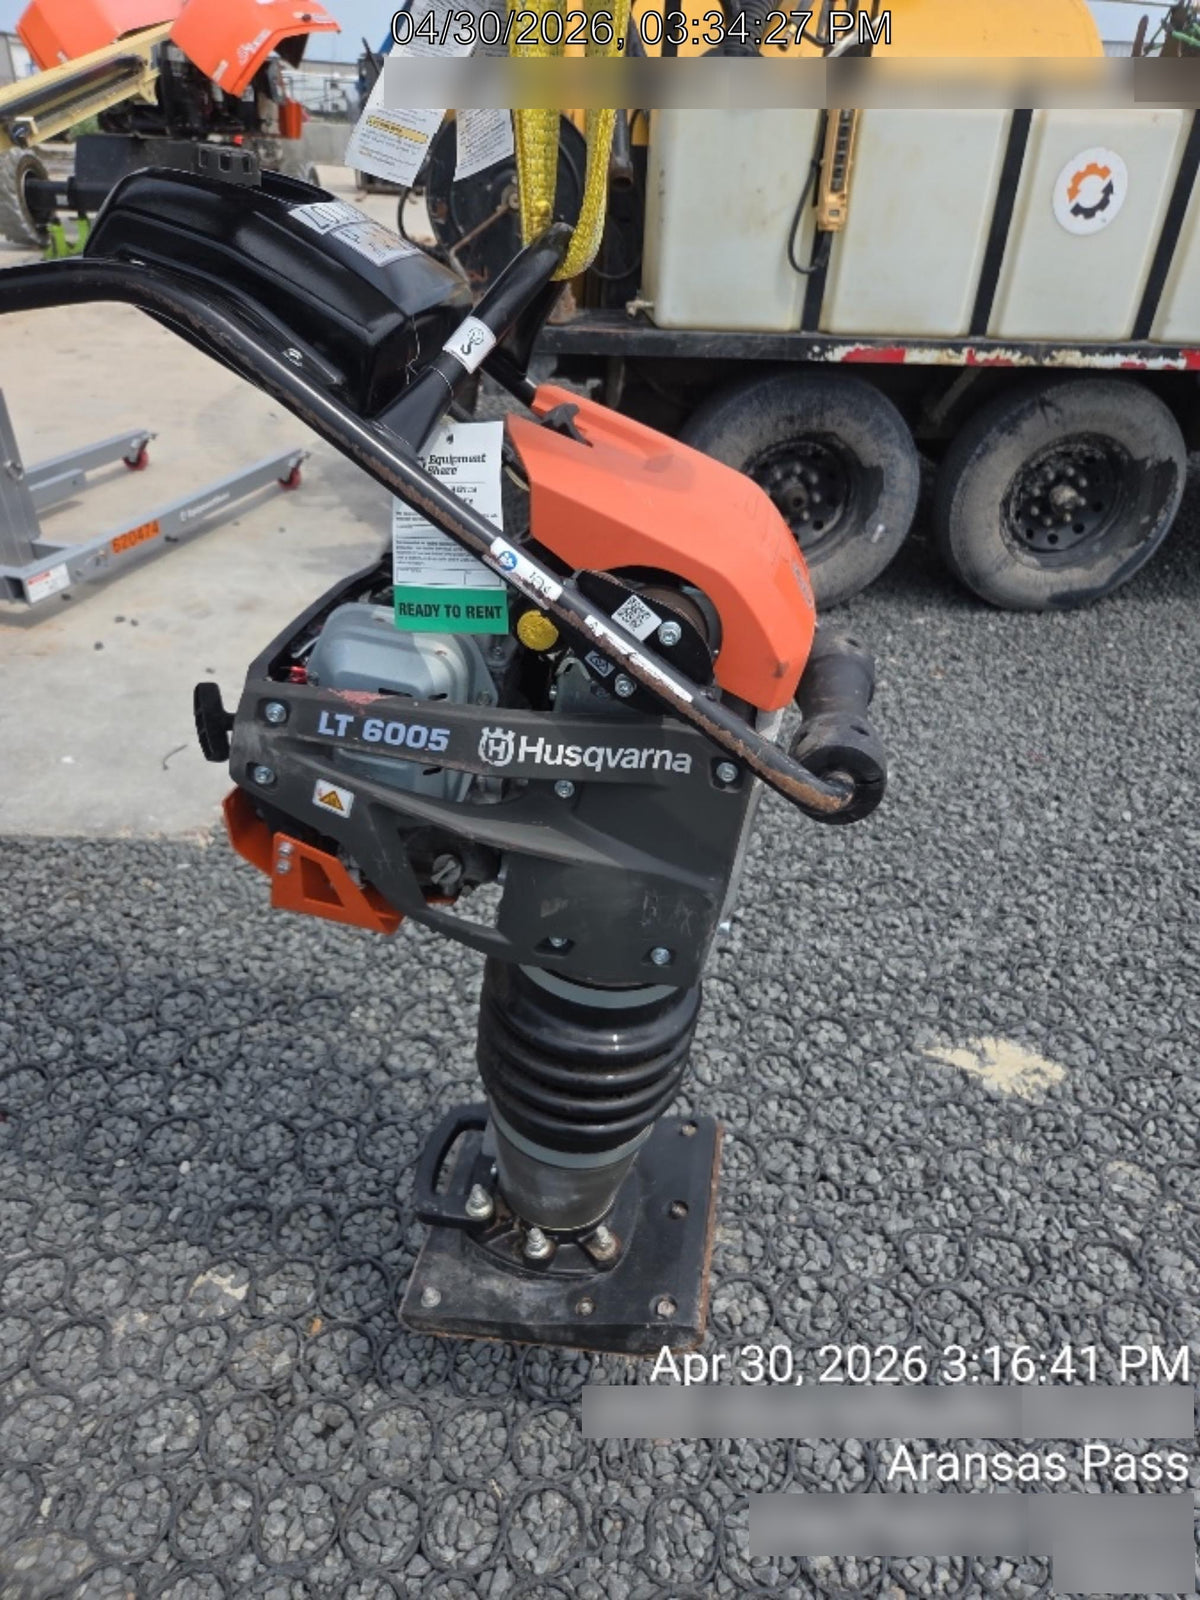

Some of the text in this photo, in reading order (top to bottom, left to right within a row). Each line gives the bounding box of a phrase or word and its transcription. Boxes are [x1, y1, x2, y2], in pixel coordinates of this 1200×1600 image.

[398, 602, 504, 620] READY TO RENT
[318, 710, 450, 752] LT 6005
[517, 735, 693, 774] Husqvarna
